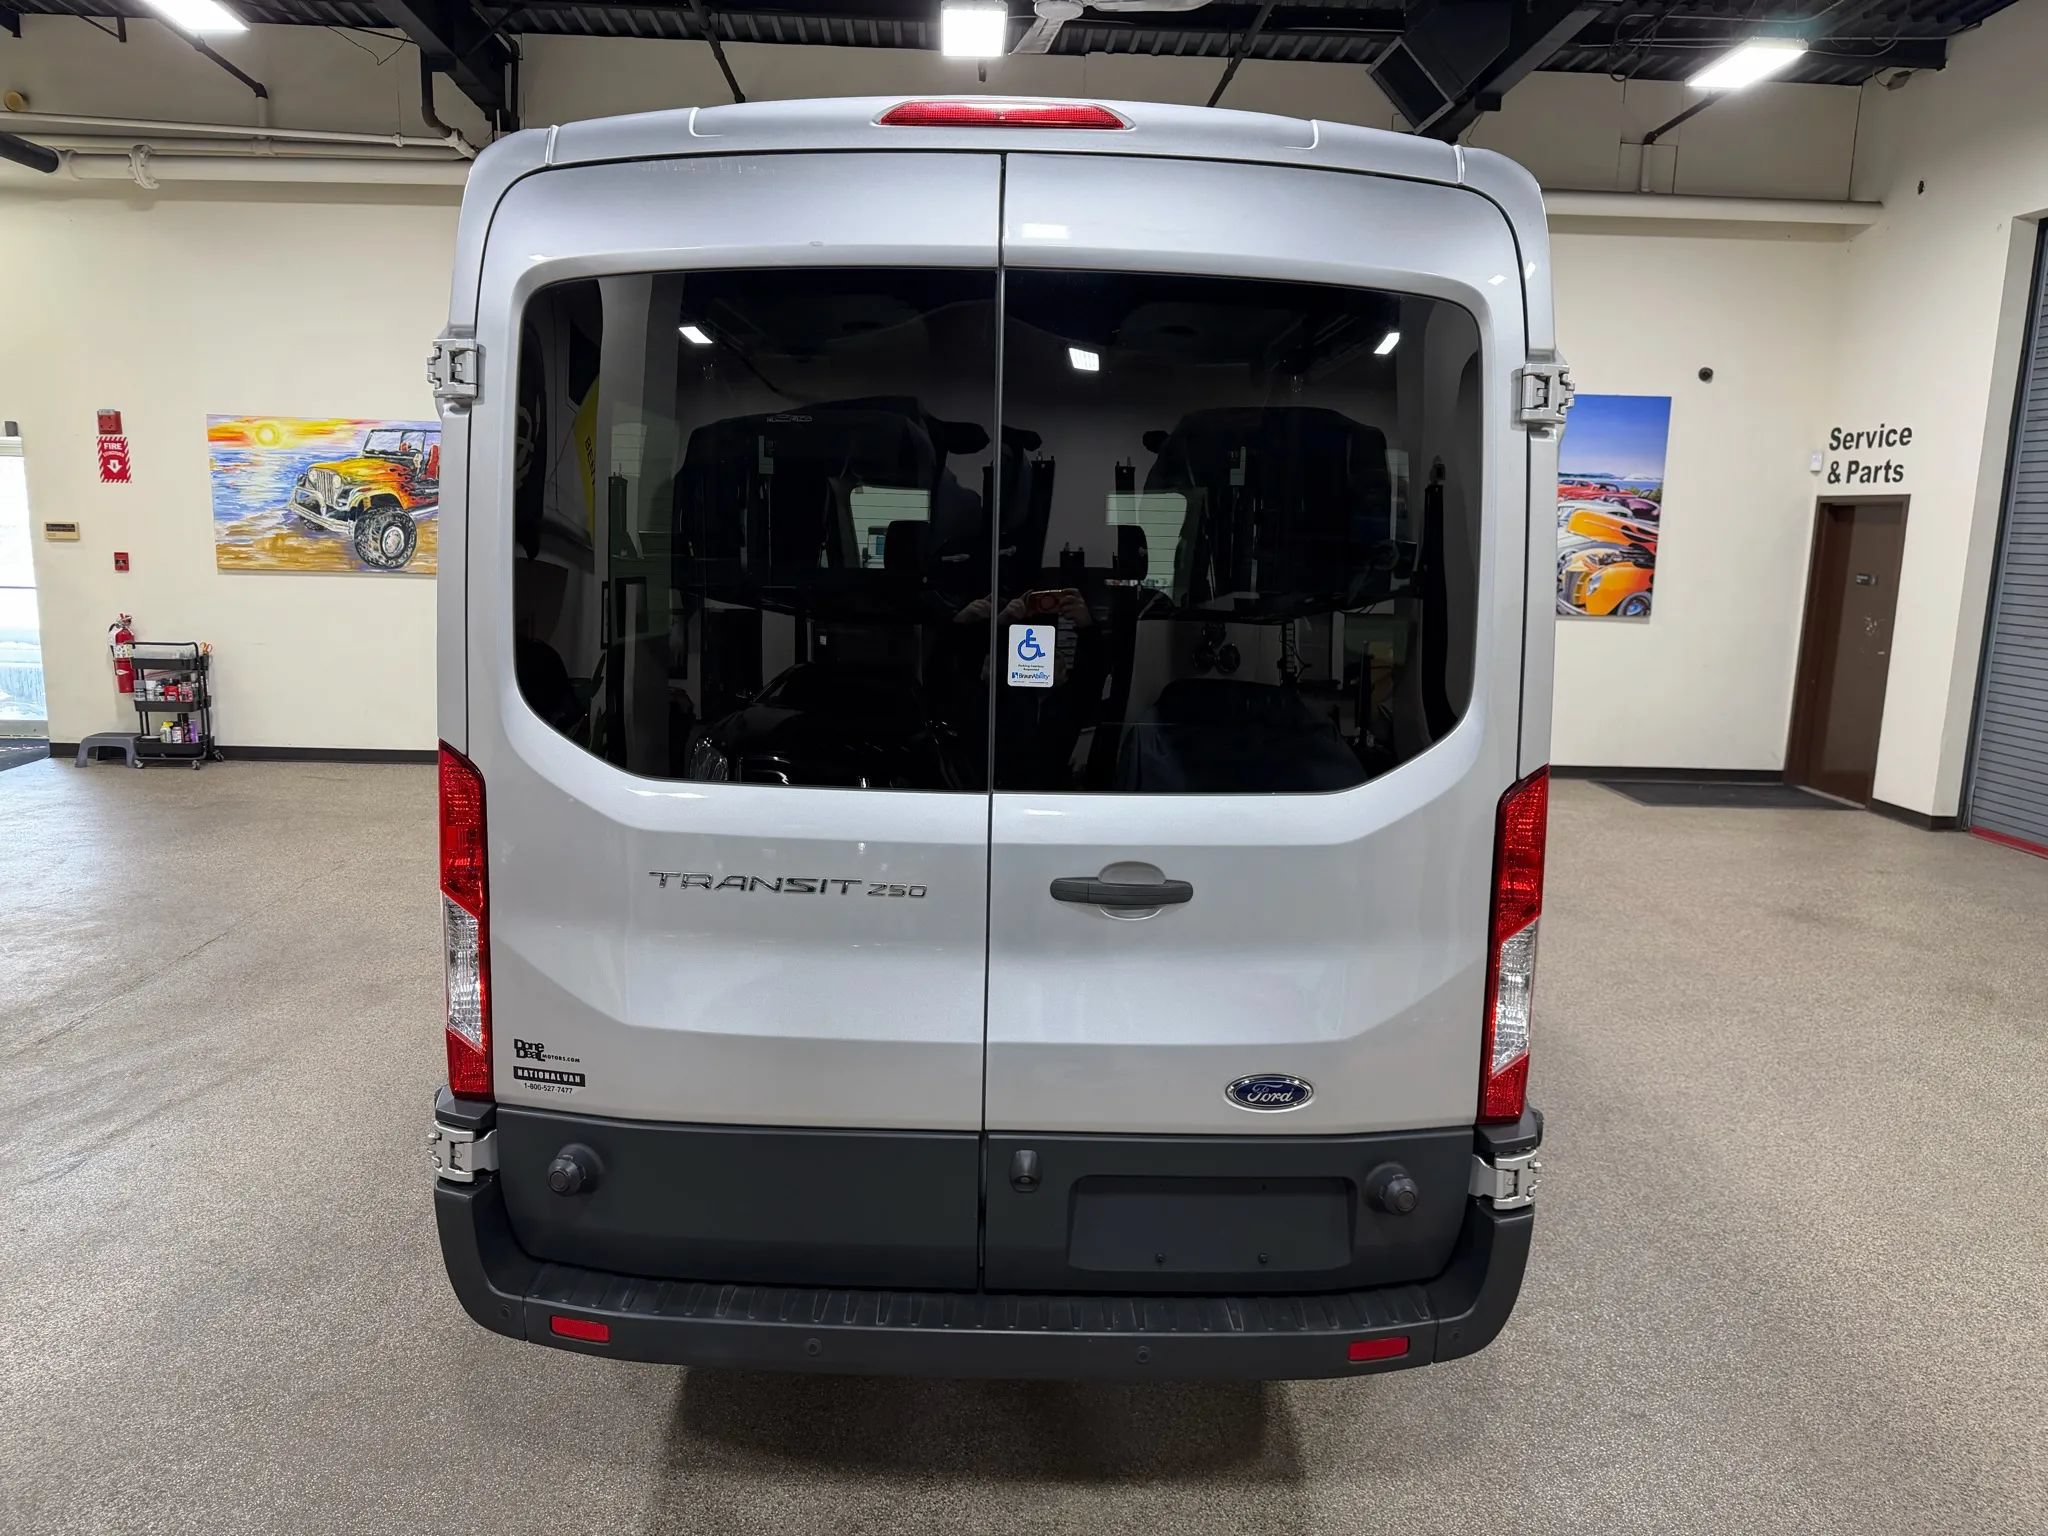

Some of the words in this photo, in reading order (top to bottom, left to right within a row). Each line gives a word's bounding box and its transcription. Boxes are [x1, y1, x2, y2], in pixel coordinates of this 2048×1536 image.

[1829, 423, 1912, 451] Service
[103, 442, 123, 451] FIRE
[1827, 460, 1841, 484] &
[1846, 459, 1904, 484] Parts
[648, 871, 863, 896] TRANSIT
[867, 882, 928, 898] 250
[513, 1038, 545, 1053] Done
[517, 1068, 561, 1081] NATIONAL
[562, 1073, 581, 1083] VAN
[524, 1082, 573, 1094] 1-800-527-7477
[1247, 1083, 1295, 1102] Ford
